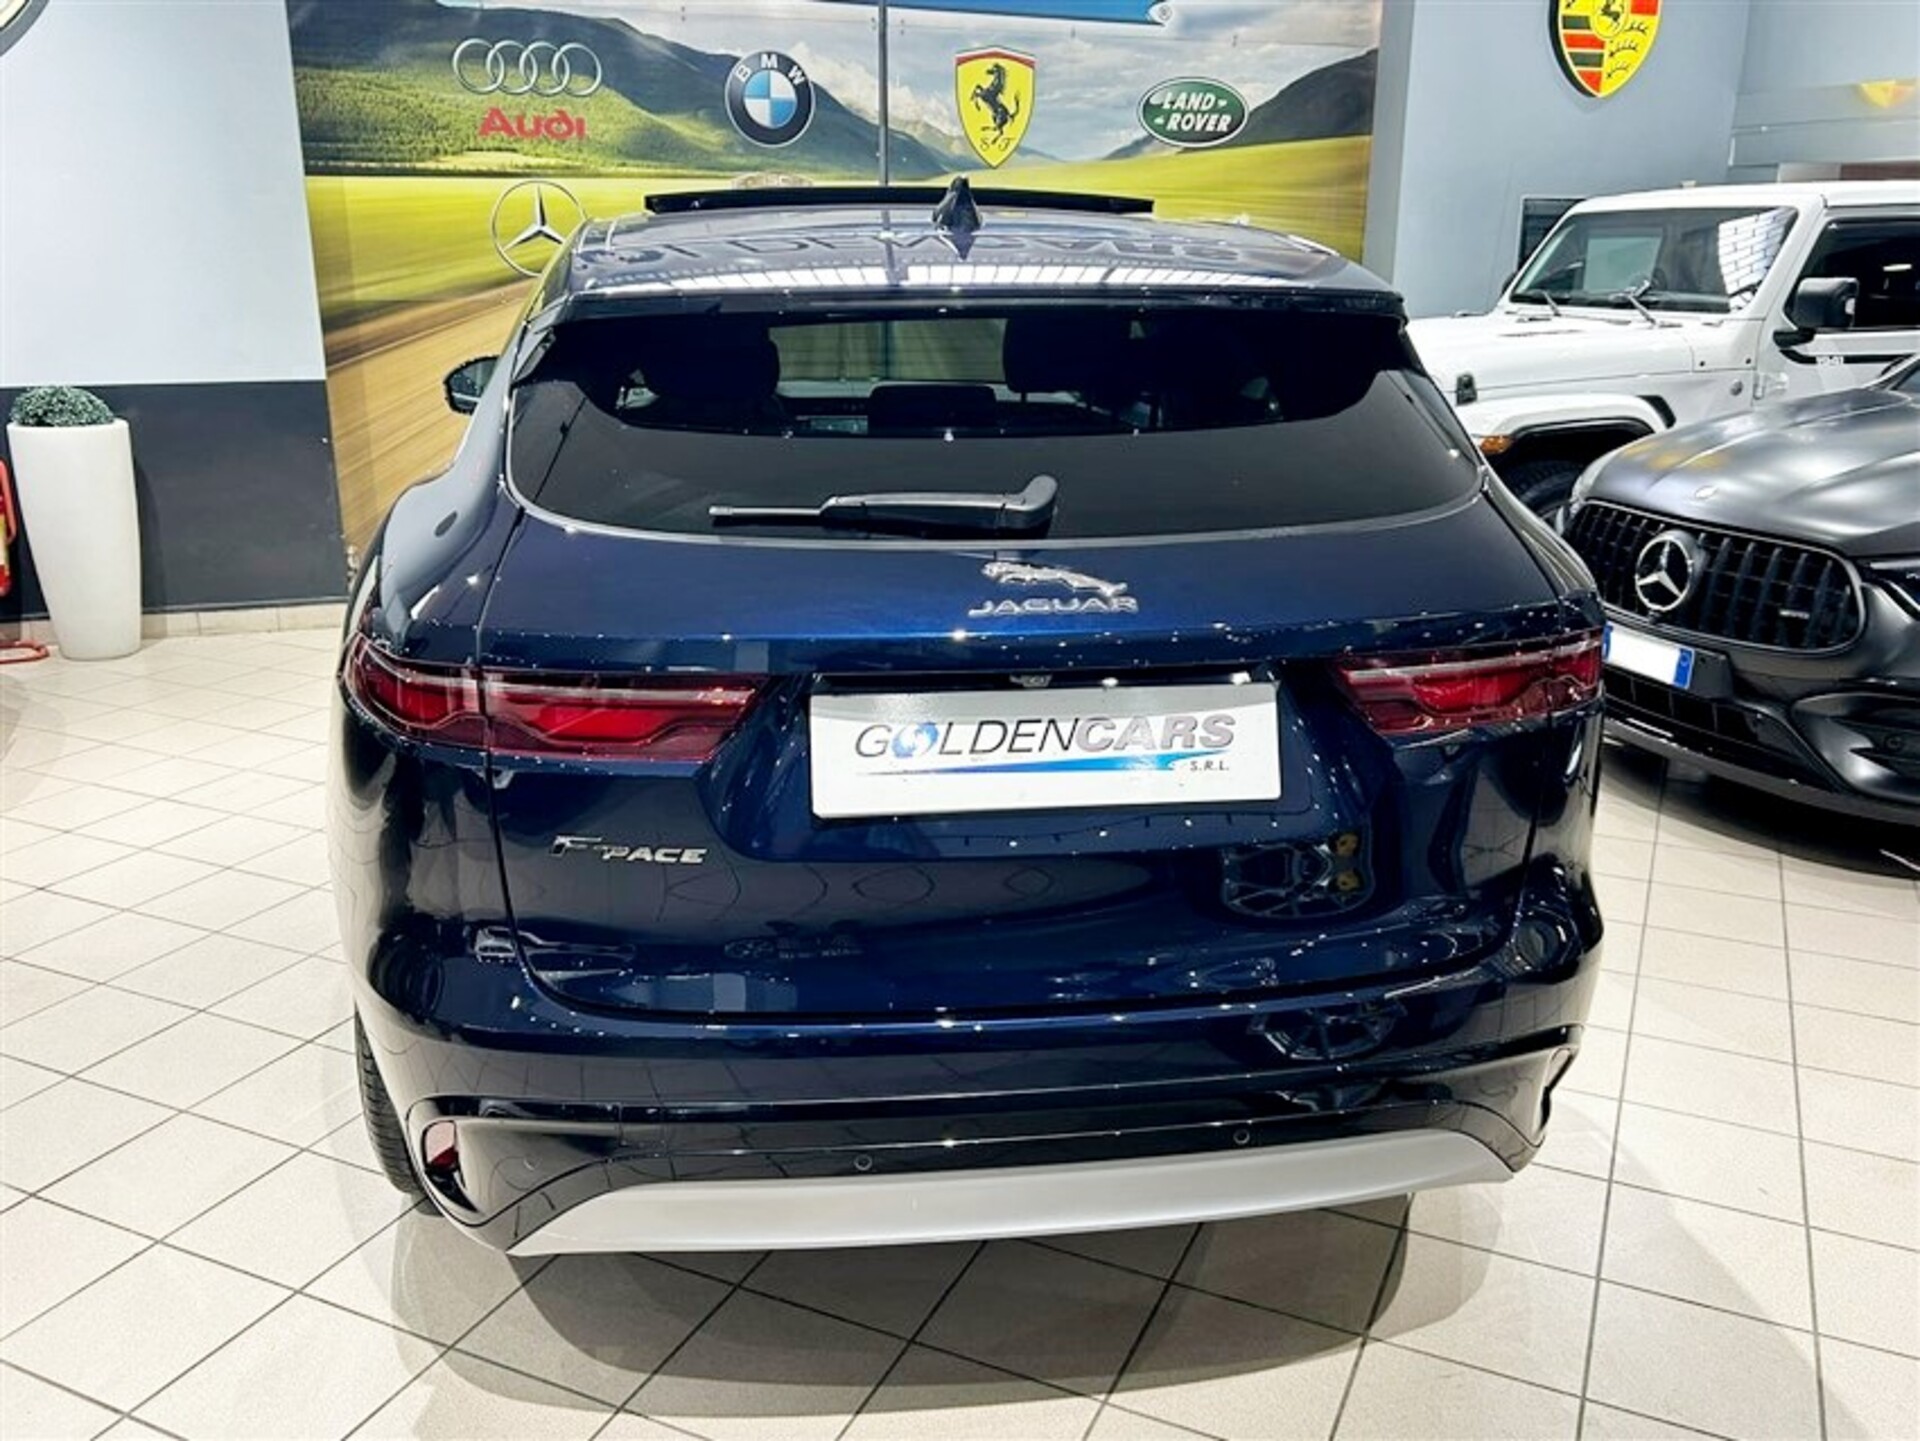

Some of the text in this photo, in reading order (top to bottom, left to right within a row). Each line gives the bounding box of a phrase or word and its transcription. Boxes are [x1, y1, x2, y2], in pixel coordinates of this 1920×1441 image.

[734, 52, 806, 86] BMW
[1161, 91, 1216, 111] LAND
[478, 106, 586, 140] Audi
[1165, 112, 1232, 132] ROVER
[968, 597, 1139, 617] JAGUAR
[1189, 759, 1231, 772] S.R.L.
